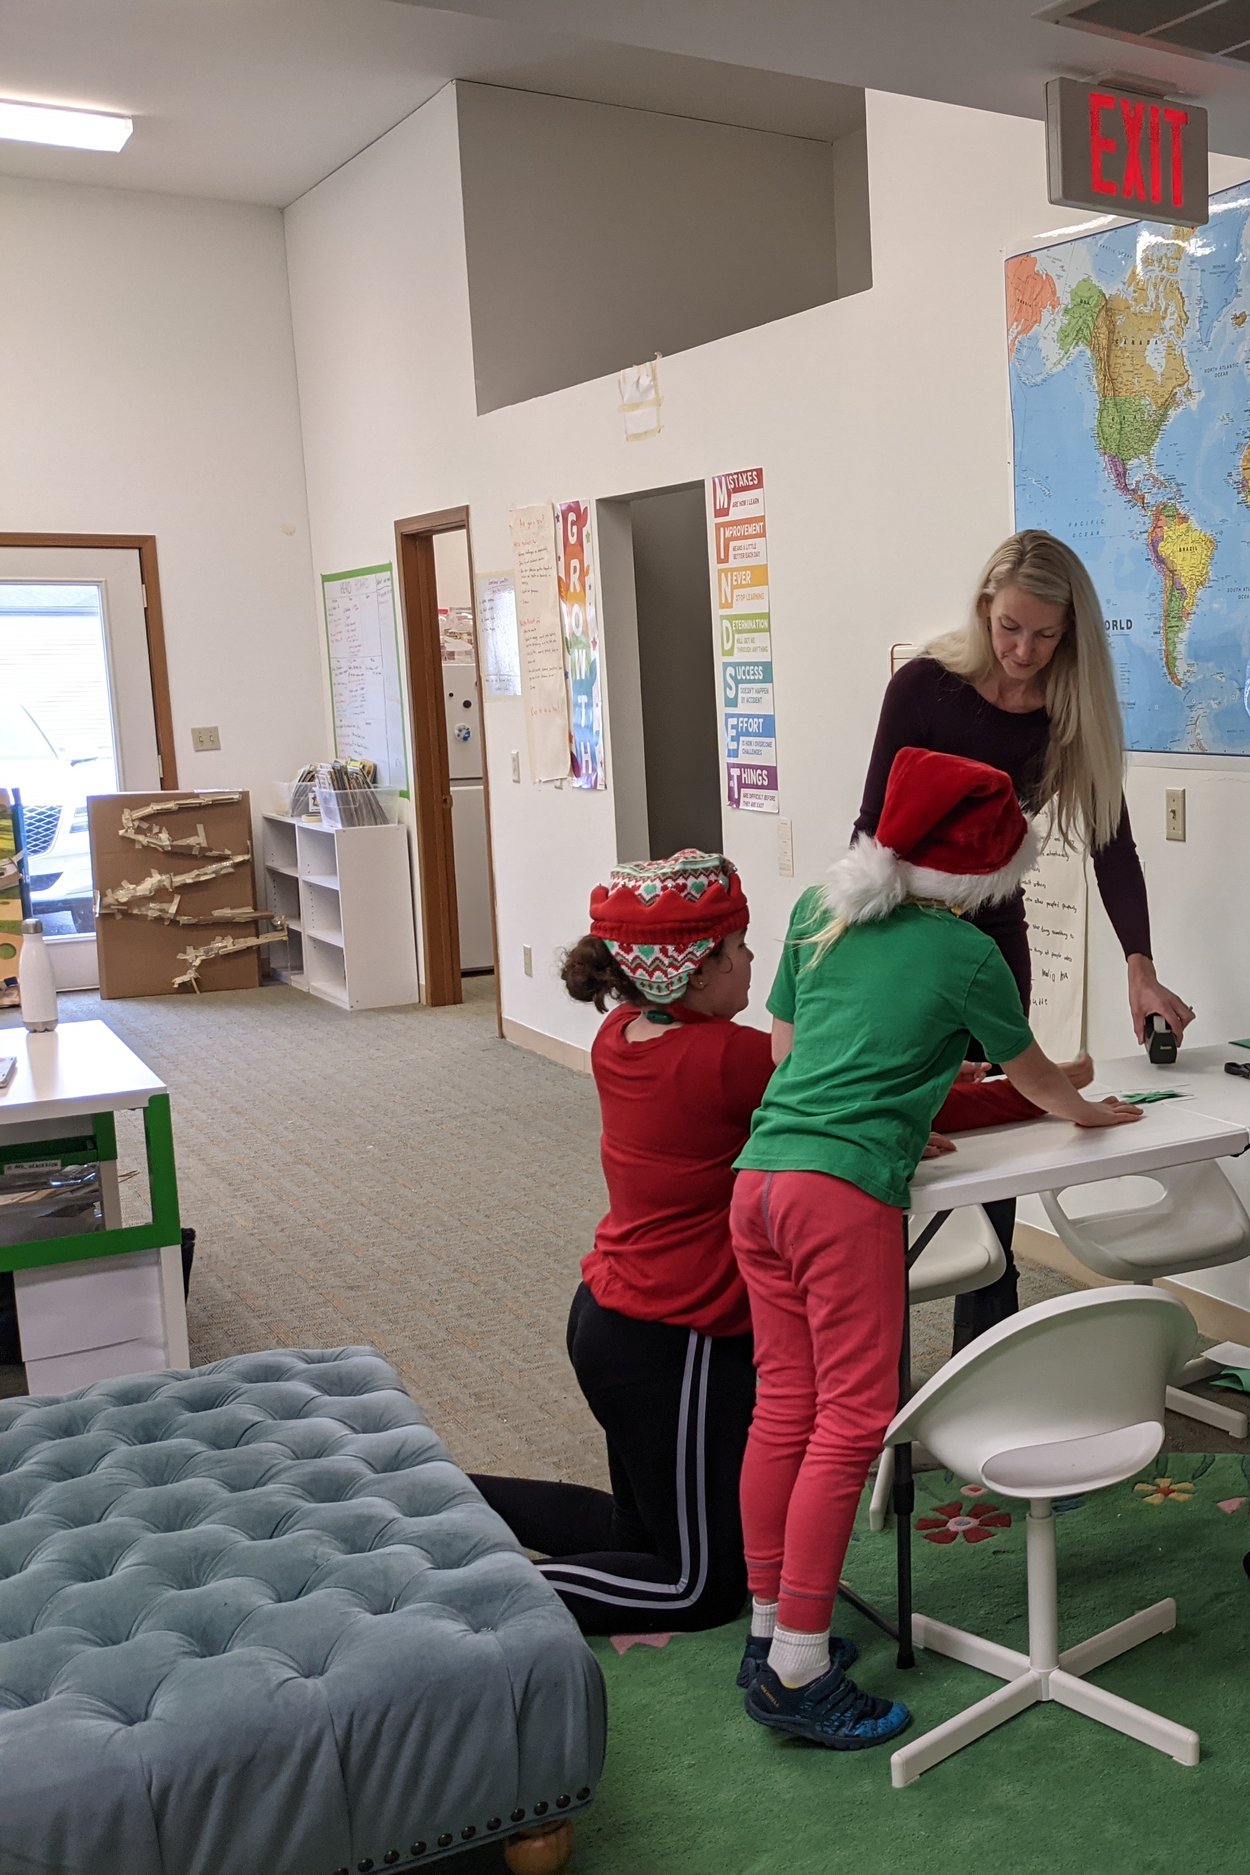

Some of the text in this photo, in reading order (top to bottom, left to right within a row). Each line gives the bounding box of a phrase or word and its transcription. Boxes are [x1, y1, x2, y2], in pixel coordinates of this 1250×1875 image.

[1088, 92, 1190, 208] EXIT
[715, 470, 758, 510] MISTAKES
[720, 521, 764, 560] IMPROVEMENT
[721, 570, 752, 604] NEVER
[722, 618, 768, 650] DETERMINATION
[1104, 618, 1133, 631] ORLD
[567, 511, 592, 774] GROWTH
[725, 665, 763, 699] SUCCESS
[727, 717, 763, 750] EFFORT
[729, 767, 769, 800] THINGS
